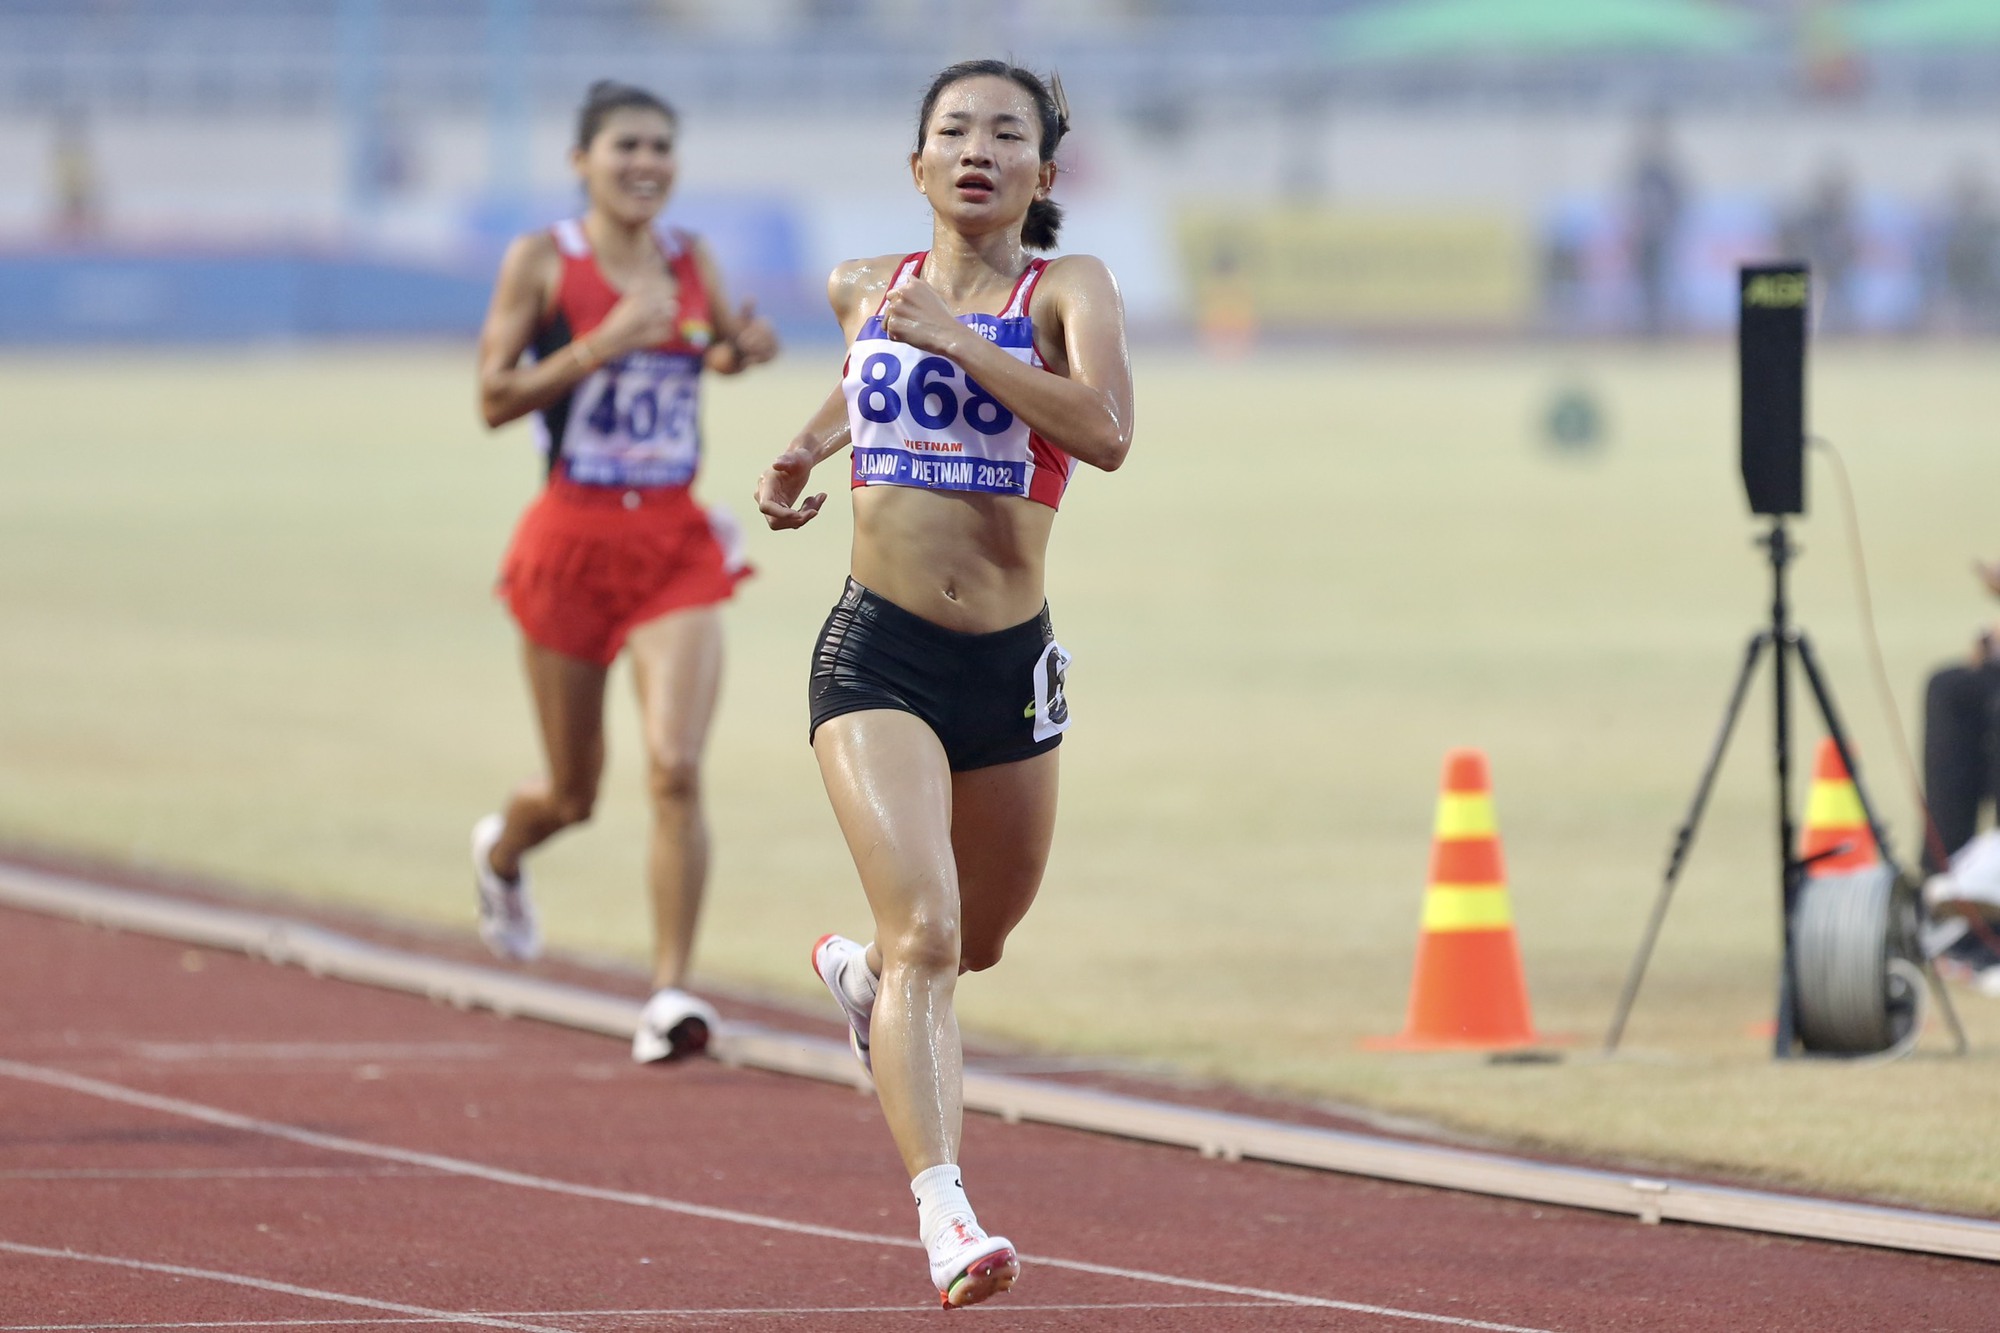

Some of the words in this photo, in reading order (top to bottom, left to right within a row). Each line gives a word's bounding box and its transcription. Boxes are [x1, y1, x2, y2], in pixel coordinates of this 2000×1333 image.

[857, 352, 1013, 436] 868
[903, 439, 963, 452] VIETNAM
[861, 453, 899, 475] HANOI
[911, 458, 973, 484] VIETNAM
[977, 464, 1013, 488] 2022
